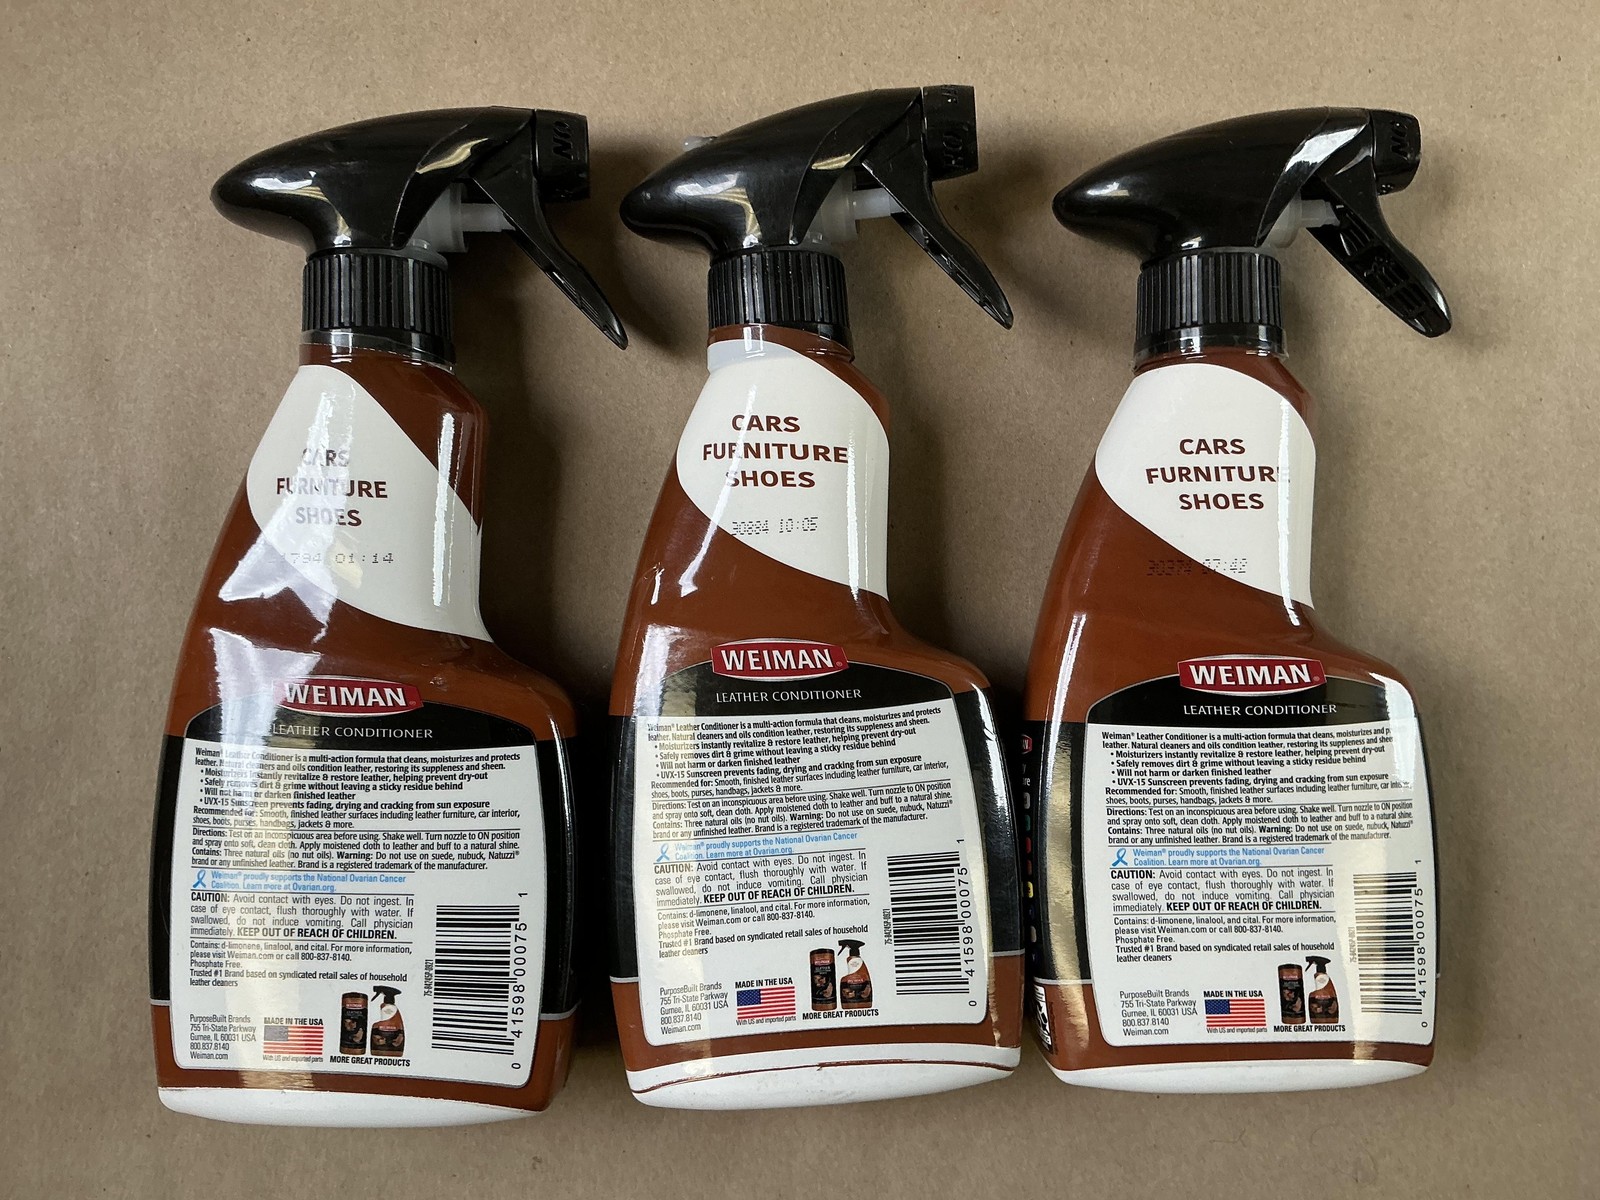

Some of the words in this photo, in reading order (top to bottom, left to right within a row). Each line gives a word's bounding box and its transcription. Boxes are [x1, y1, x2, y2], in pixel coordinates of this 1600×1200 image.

[732, 414, 801, 433] CARS
[703, 442, 849, 464] FURNITURE
[1179, 438, 1246, 455] CARS
[302, 448, 350, 467] CARS
[726, 470, 816, 488] SHOES
[1145, 465, 1290, 484] FURNITUR
[276, 477, 388, 499] FURNITURE
[1178, 493, 1265, 510] SHOES
[296, 507, 362, 527] SHOES
[335, 552, 394, 564] 01:14
[715, 691, 769, 703] LEATHER
[772, 688, 862, 701] CONDITIONER
[1183, 705, 1242, 716] LEATHER
[1245, 704, 1338, 716] CONDITIONER
[273, 724, 330, 737] LEATHER
[334, 727, 433, 739] CONDITIONER
[1165, 733, 1207, 741] Conditioner
[1312, 731, 1335, 740] cleans,
[1336, 729, 1372, 738] moisturizes
[1116, 750, 1163, 758] Moisturizers
[1165, 751, 1198, 760] instantly
[1275, 750, 1303, 758] leather,
[1305, 749, 1332, 758] helping
[1334, 748, 1360, 757] prevent
[1362, 746, 1385, 755] dry-out
[1116, 759, 1139, 769] Safely
[1200, 760, 1223, 769] grime
[1225, 759, 1255, 767] without
[1257, 758, 1284, 767] leaving
[1292, 757, 1313, 766] sticky
[1315, 756, 1341, 765] residue
[1343, 755, 1366, 763] behind
[191, 892, 230, 902] CAUTION:
[233, 894, 255, 903] Avoid
[259, 894, 288, 904] contact
[292, 895, 311, 904] with
[315, 897, 336, 906] eyes.
[341, 896, 352, 905] Do
[356, 897, 370, 906] not
[374, 897, 401, 908] ingest.
[406, 897, 413, 906] In
[958, 866, 971, 919] 00075
[658, 911, 688, 920] Contains:
[689, 907, 730, 918] d-limonene,
[731, 905, 758, 915] linalool,
[760, 904, 773, 912] and
[775, 903, 792, 911] cital.
[794, 902, 806, 910] For
[807, 901, 826, 909] more
[826, 897, 870, 908] information,
[1414, 888, 1425, 940] 00075
[191, 916, 230, 925] swallowed,
[237, 917, 246, 925] do
[253, 918, 265, 926] not
[273, 918, 299, 926] induce
[306, 918, 343, 928] vomiting.
[351, 919, 366, 928] Call
[374, 919, 413, 930] physician
[658, 921, 679, 931] please
[681, 919, 694, 928] visit
[695, 916, 741, 927] Weiman.com
[752, 914, 765, 922] call
[767, 911, 815, 921] 800-837-8140.
[191, 927, 234, 937] immediately.
[237, 928, 259, 936] KEEP
[262, 928, 281, 937] OUT
[284, 929, 295, 937] OF
[298, 929, 329, 938] REACH
[332, 929, 344, 938] OF
[346, 929, 397, 940] CHILDREN.
[658, 930, 692, 939] Phosphate
[659, 939, 682, 949] Trusted
[694, 937, 714, 945] Brand
[715, 935, 735, 944] based
[747, 931, 783, 943] syndicated
[785, 930, 803, 938] retail
[804, 926, 822, 936] sales
[824, 927, 832, 935] of
[833, 925, 868, 934] household
[513, 922, 527, 977] 00075
[659, 949, 680, 958] leather
[682, 947, 708, 956] cleaners
[962, 925, 975, 977] 41598
[1417, 946, 1427, 998] 41598
[735, 980, 755, 989] MADE
[757, 979, 764, 987] IN
[765, 978, 777, 986] THE
[778, 977, 793, 986] USA
[1120, 989, 1163, 999] PurposeBuilt
[1165, 989, 1189, 997] Brands
[1121, 1000, 1134, 1008] 755
[1135, 999, 1165, 1008] Tri-State
[1167, 998, 1197, 1008] Parkway
[511, 984, 525, 1039] 41598
[802, 1012, 822, 1020] MORE
[823, 1010, 843, 1019] GREAT
[845, 1009, 879, 1017] PRODUCTS
[1121, 1009, 1149, 1018] Gurnee,
[1158, 1008, 1181, 1016] 60031
[1182, 1008, 1197, 1016] USA
[264, 1017, 284, 1025] MADE
[309, 1018, 324, 1026] USA
[1122, 1017, 1170, 1027] 800.837.8140
[1314, 1024, 1345, 1032] PRODUCTS
[1123, 1027, 1169, 1036] Weiman.com
[330, 1056, 350, 1064] MORE
[351, 1057, 372, 1065] GREAT
[374, 1058, 410, 1067] PRODUCTS
